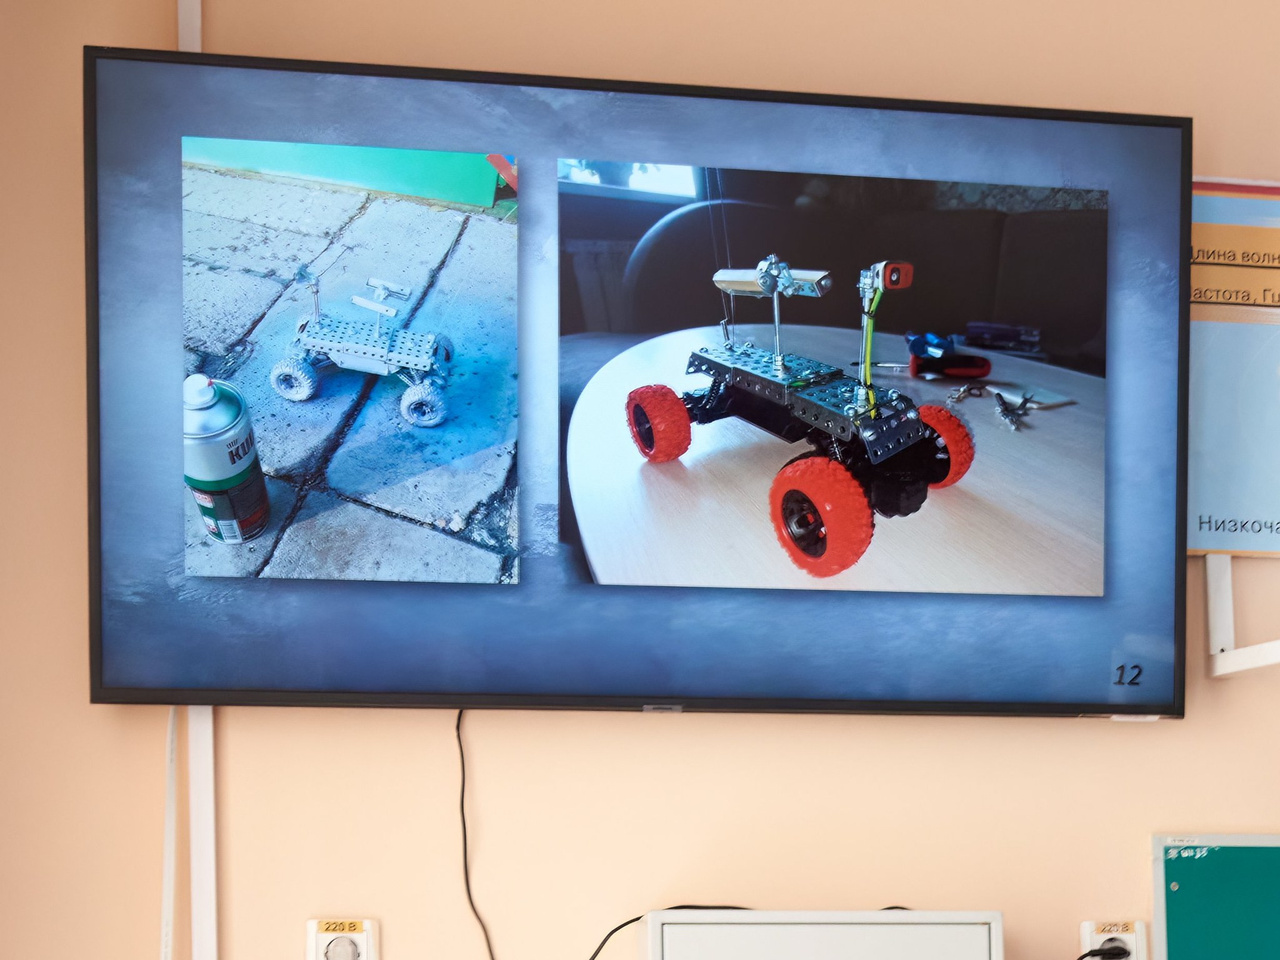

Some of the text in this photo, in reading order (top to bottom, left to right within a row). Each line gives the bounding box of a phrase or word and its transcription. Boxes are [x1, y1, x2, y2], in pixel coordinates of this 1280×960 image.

[1191, 246, 1236, 263] лина
[1113, 664, 1143, 686] 12
[324, 922, 357, 932] 220 В
